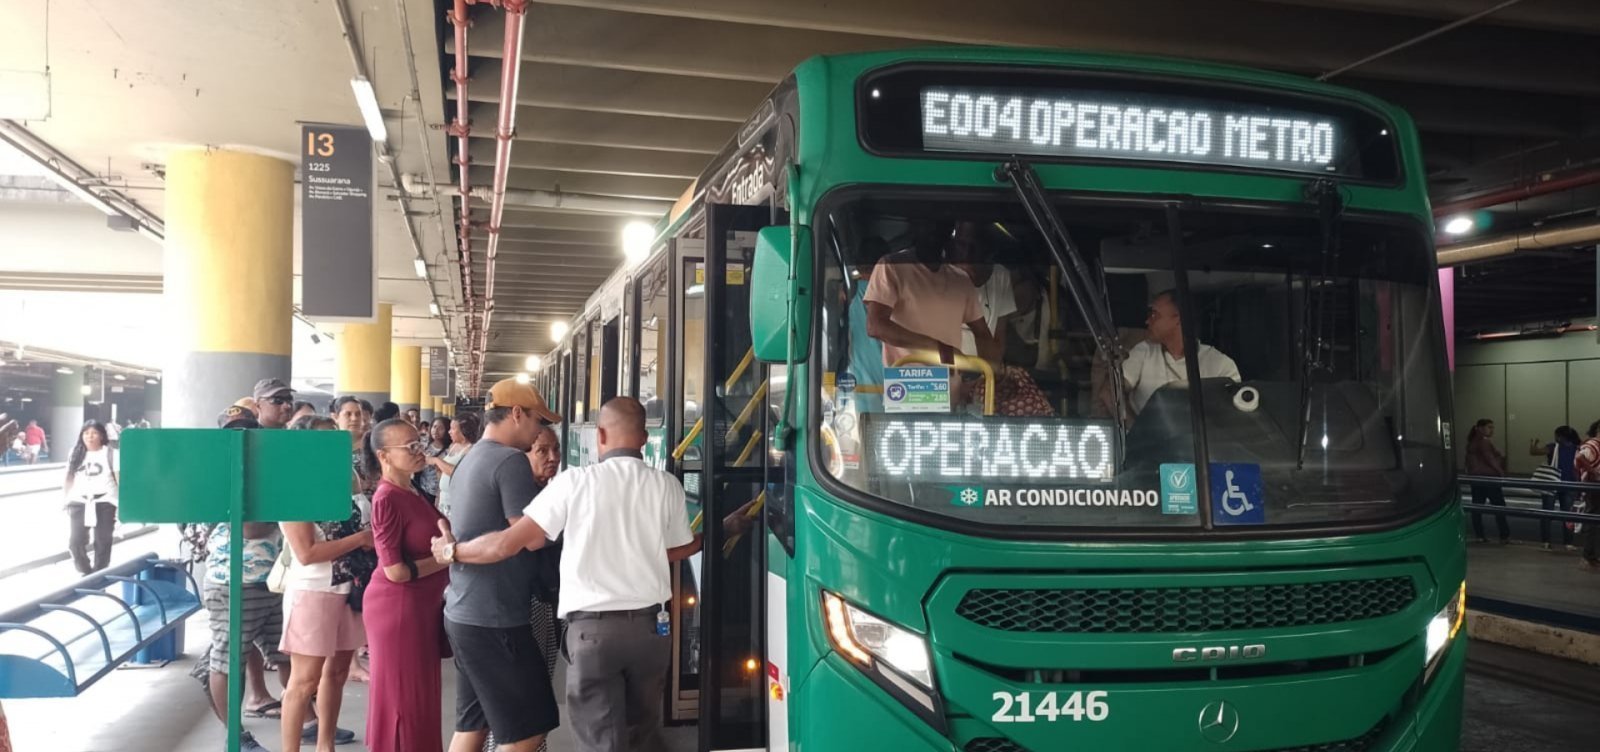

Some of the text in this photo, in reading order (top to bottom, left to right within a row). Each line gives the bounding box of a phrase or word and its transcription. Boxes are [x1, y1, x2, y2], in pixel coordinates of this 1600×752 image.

[924, 91, 1335, 163] E004 OPERACAO METRO
[308, 163, 330, 171] 1225
[308, 175, 351, 185] Sussuarana
[731, 160, 764, 205] Entrada
[899, 369, 933, 378] TARIFA
[881, 420, 1111, 479] OPERACAO
[984, 488, 1159, 507] AR CONDICIONADO
[991, 690, 1110, 723] 21446
